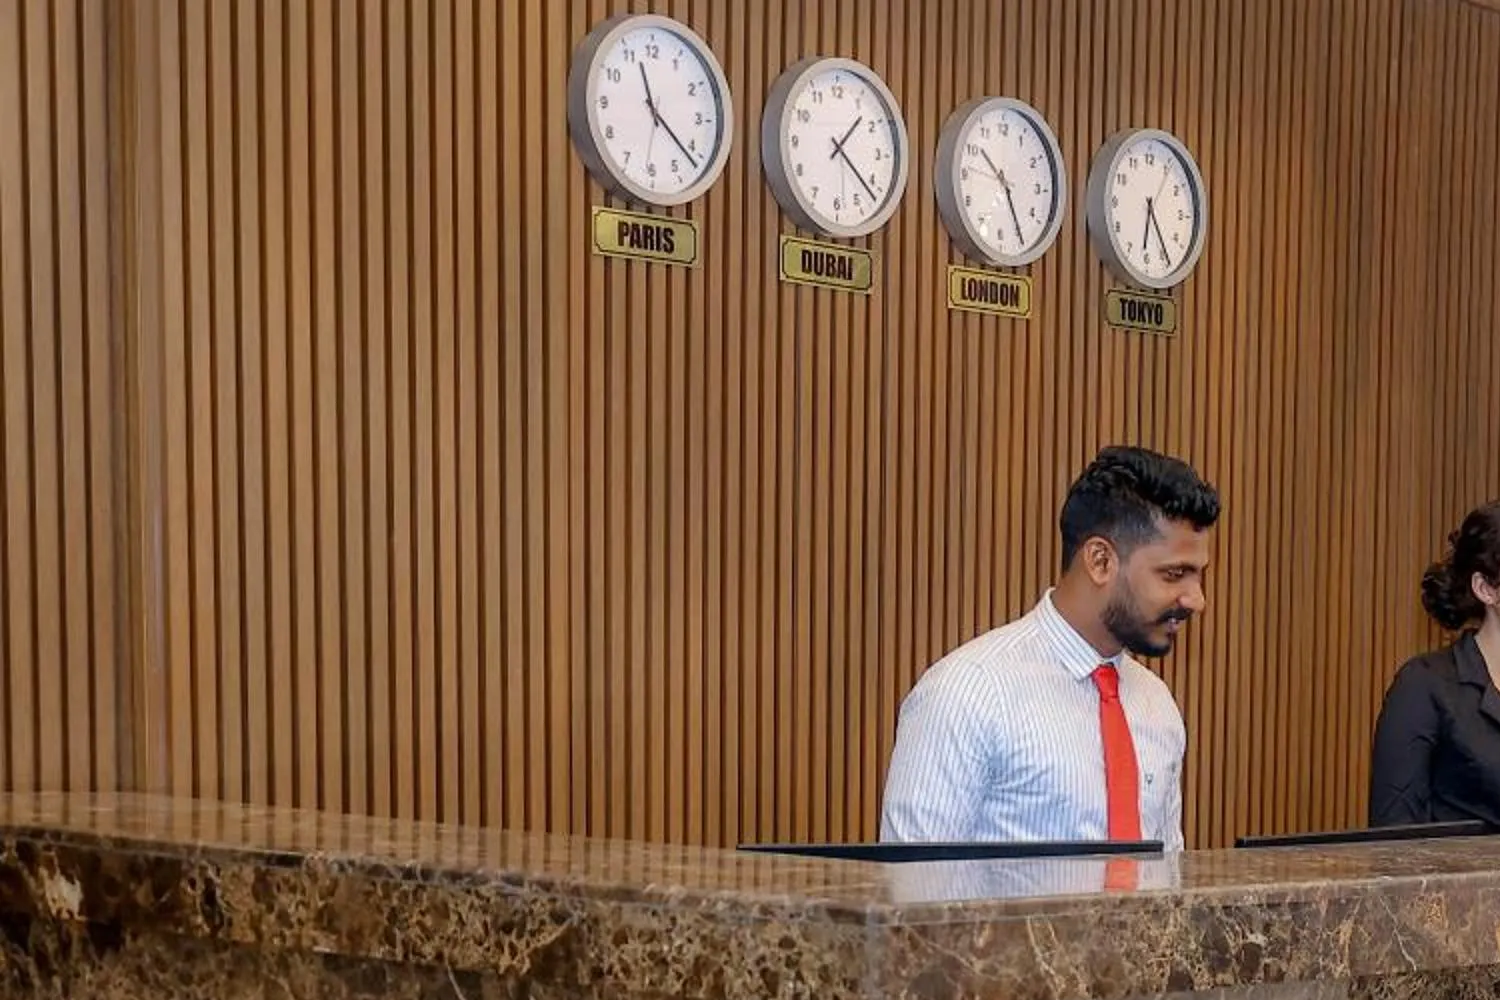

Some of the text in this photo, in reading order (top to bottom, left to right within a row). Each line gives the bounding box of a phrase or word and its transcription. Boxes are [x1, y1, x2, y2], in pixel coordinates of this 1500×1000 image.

[623, 48, 635, 63] 11
[645, 44, 659, 59] 12
[606, 68, 621, 83] 10
[617, 220, 675, 254] PARIS
[801, 249, 853, 281] DUBAI
[961, 277, 1020, 307] LONDON
[1119, 298, 1164, 326] TOKYO
